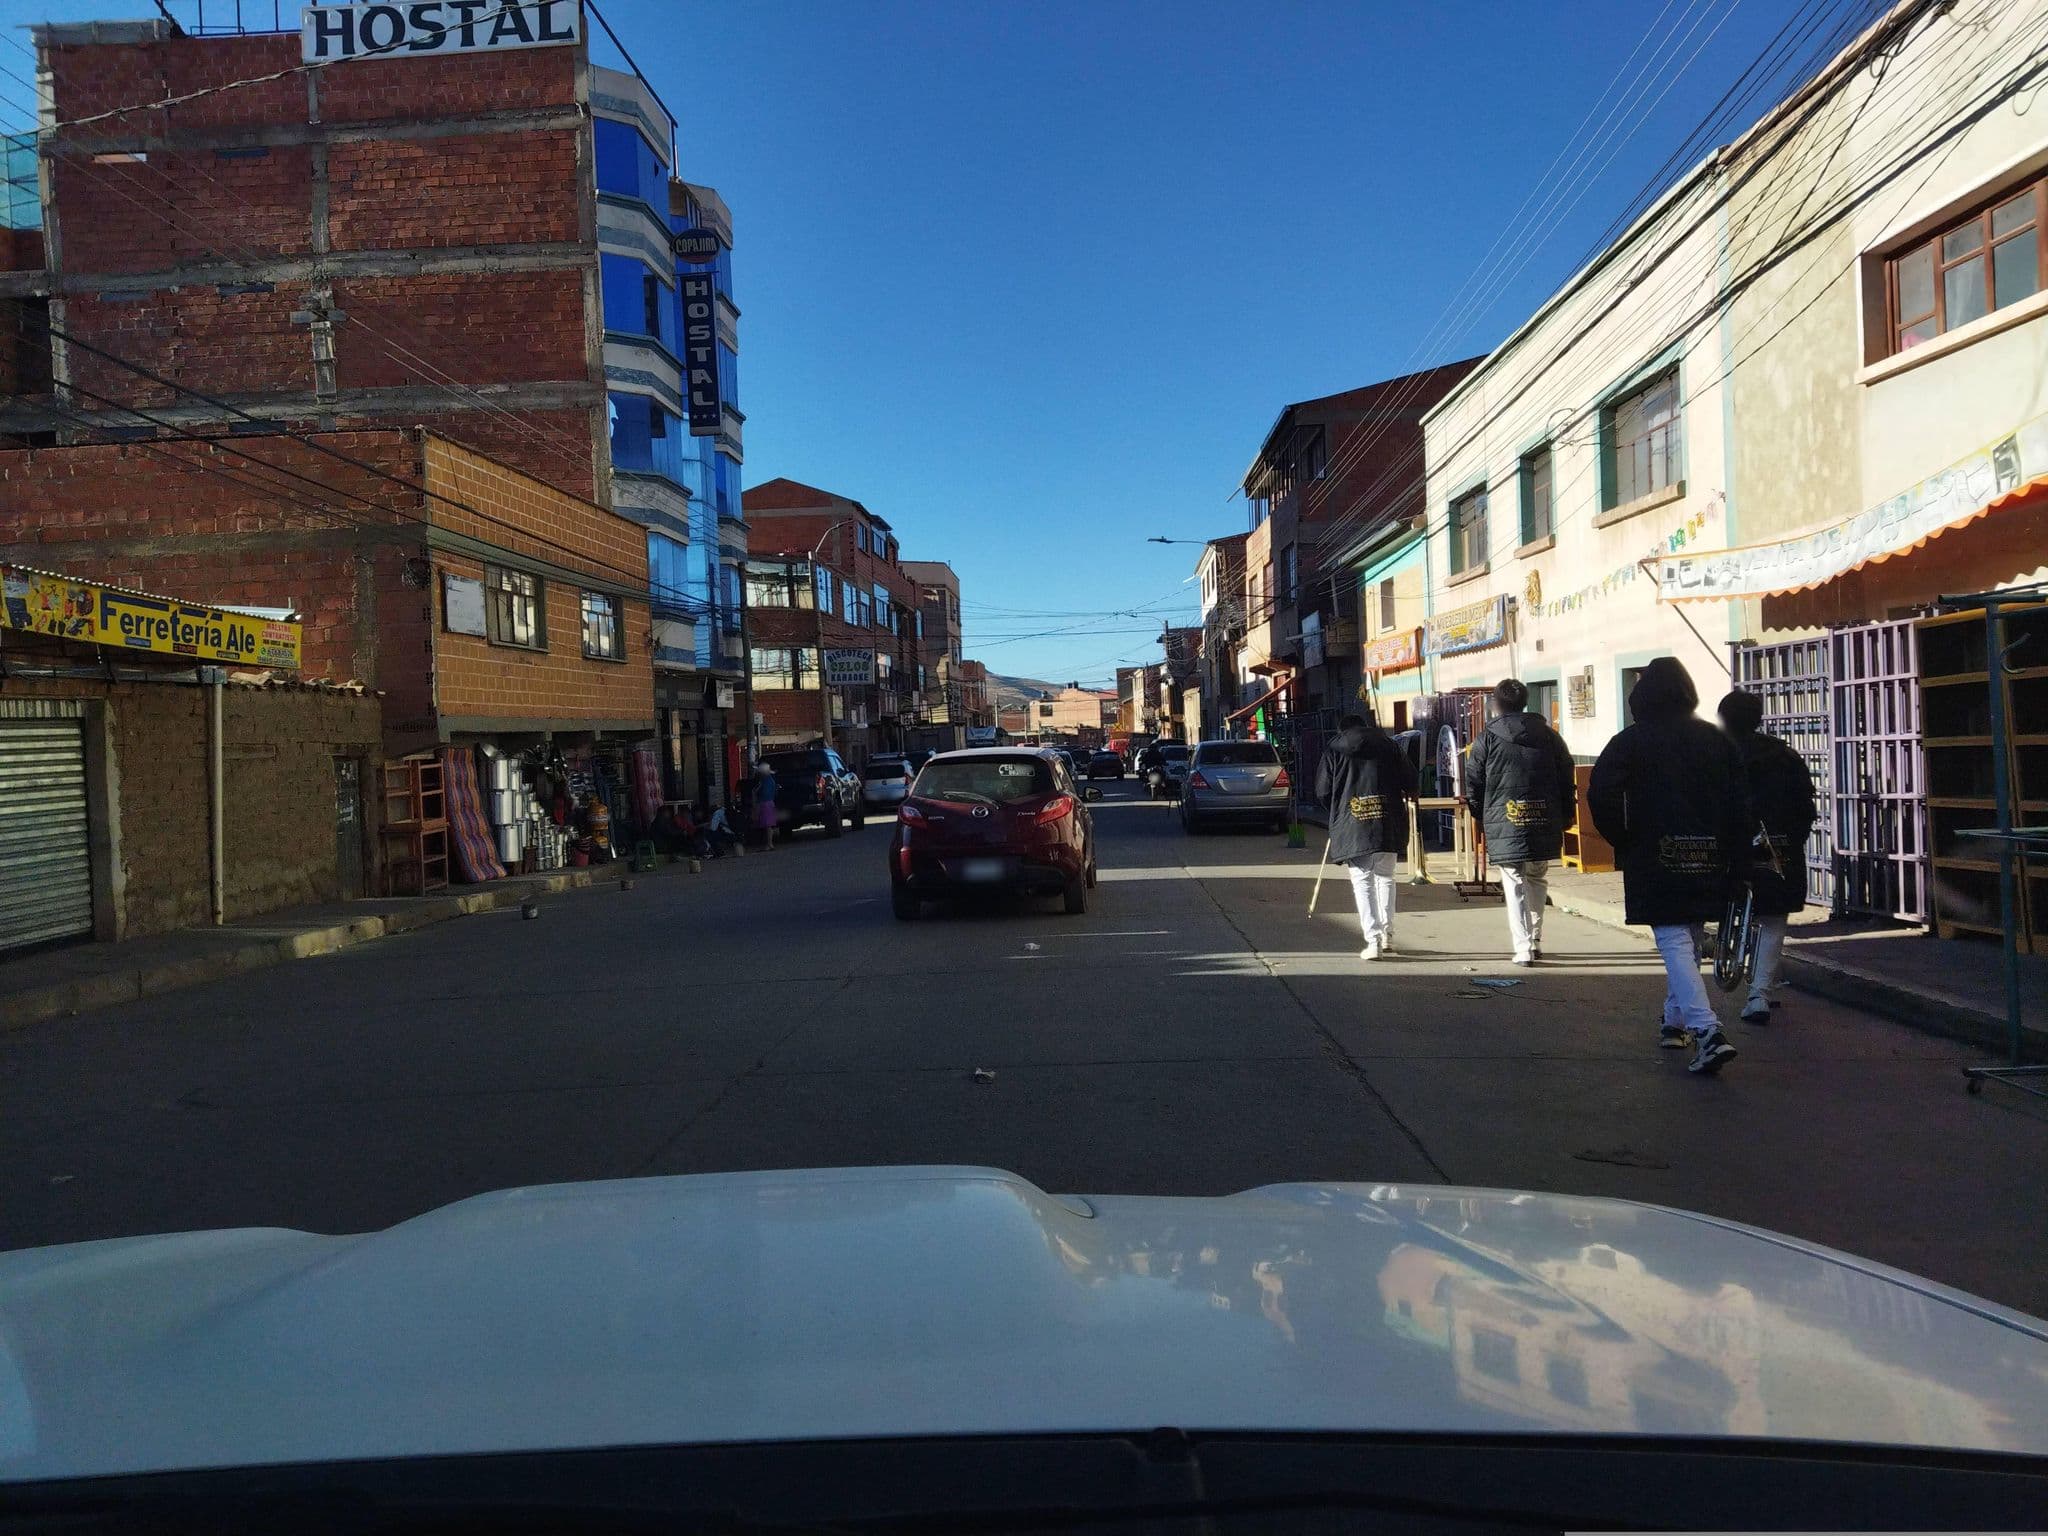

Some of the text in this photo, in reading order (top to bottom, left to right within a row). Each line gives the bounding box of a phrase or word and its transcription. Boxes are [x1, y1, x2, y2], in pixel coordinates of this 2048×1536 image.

[309, 0, 575, 57] HOSTAL
[675, 237, 718, 253] COPAJIRA
[685, 280, 715, 406] HOSTAL
[100, 593, 255, 653] Ferretería Ale
[827, 649, 872, 663] DISCOTECA
[831, 673, 869, 682] KARAOKE
